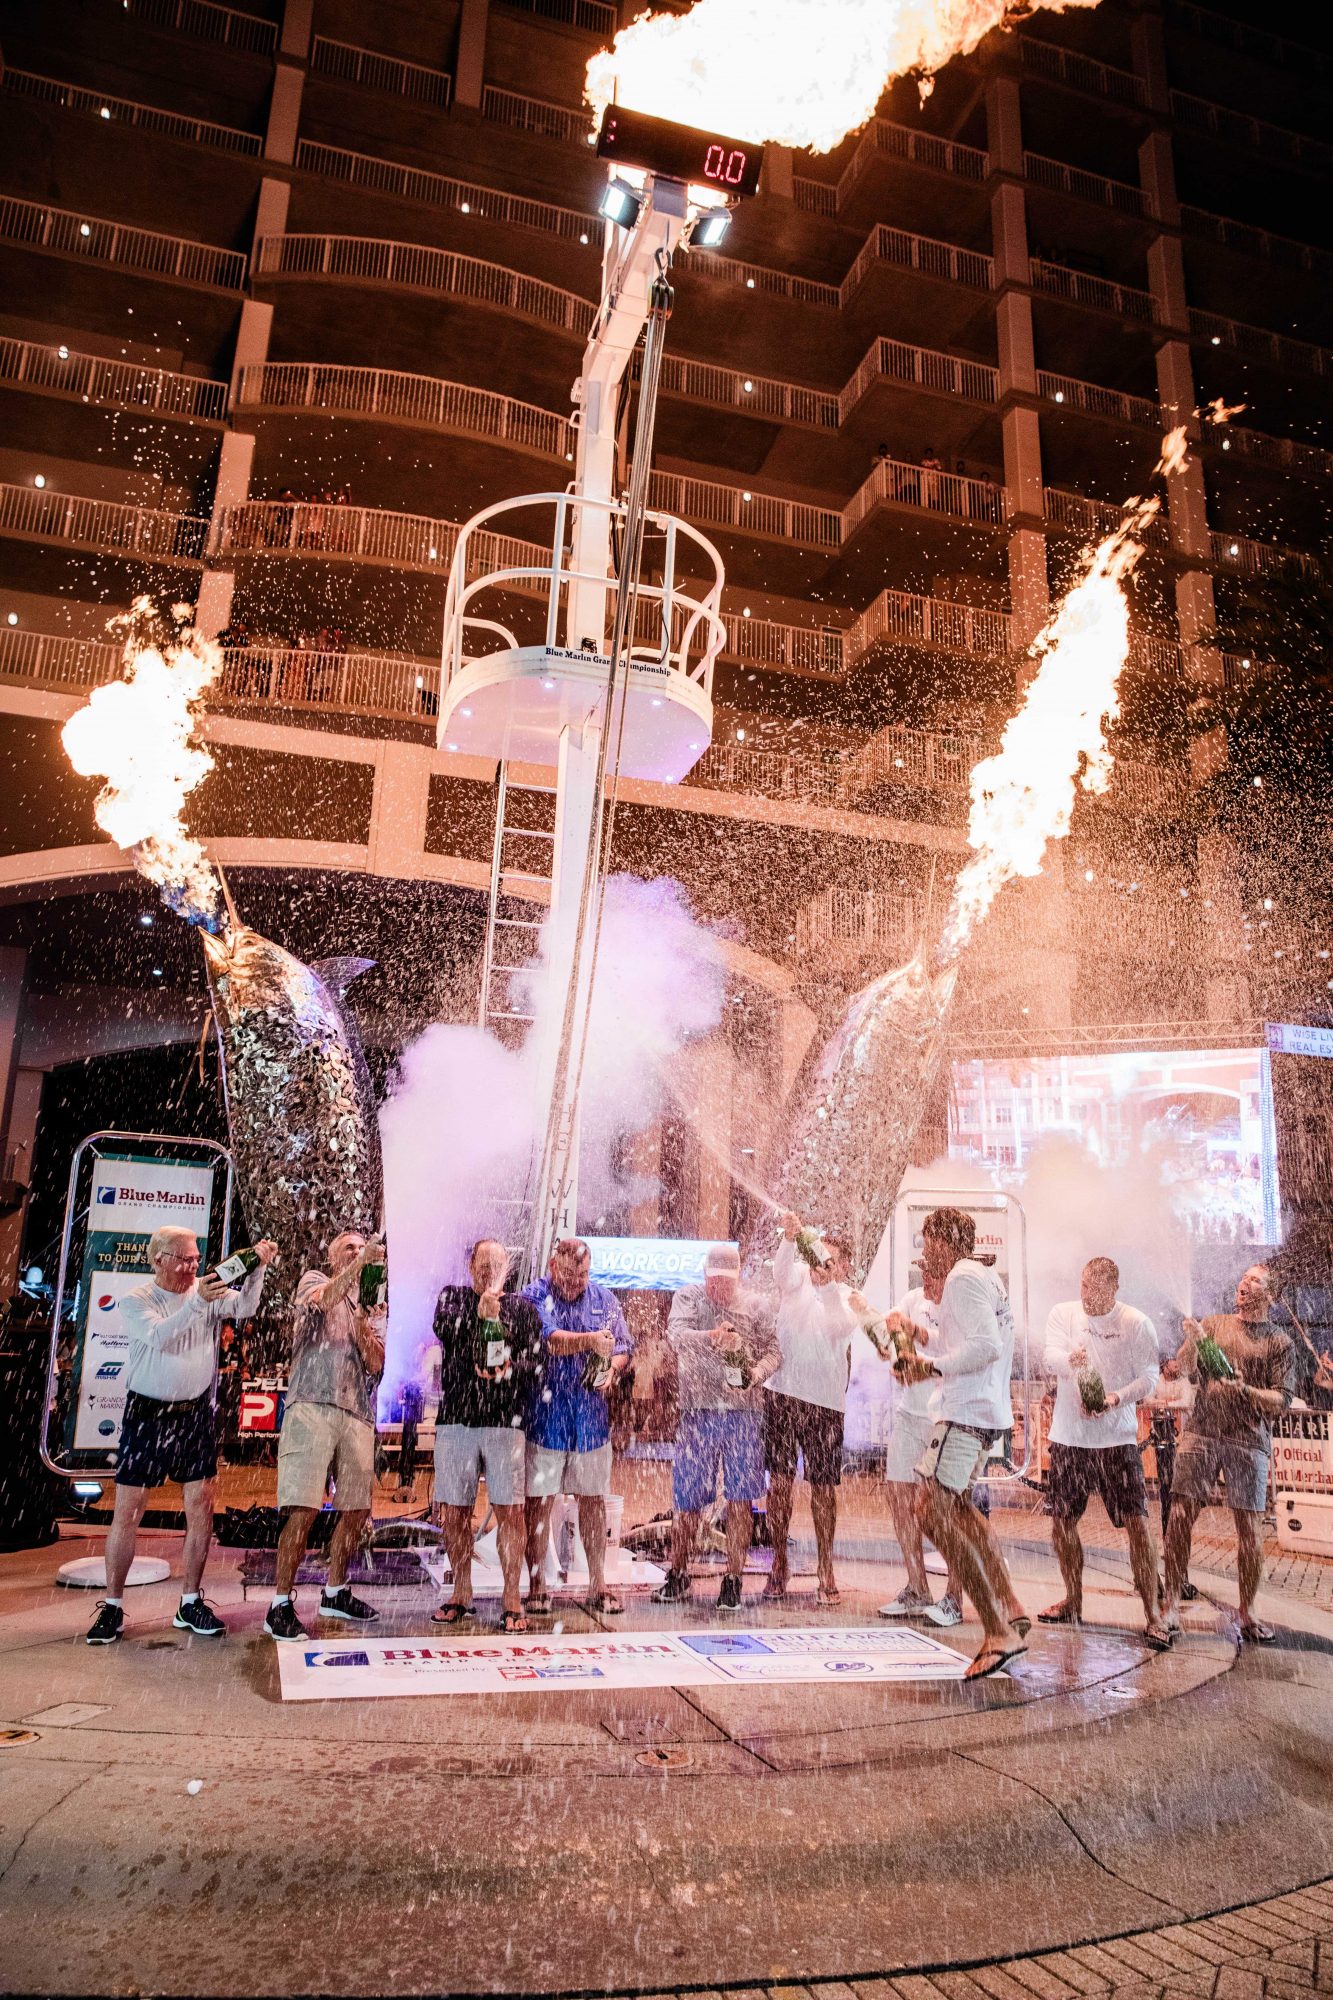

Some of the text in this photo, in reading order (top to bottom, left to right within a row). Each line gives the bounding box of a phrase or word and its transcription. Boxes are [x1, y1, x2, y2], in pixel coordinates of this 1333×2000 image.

[704, 145, 746, 184] 0.0
[545, 647, 563, 657] Blue
[565, 651, 591, 663] Marlin
[593, 656, 611, 665] Gran
[1293, 1029, 1317, 1040] WISE
[1290, 1041, 1317, 1052] REAL
[119, 1187, 205, 1206] Blue Marlin
[147, 1203, 205, 1212] CHAMPIONSHIP
[974, 1234, 1003, 1245] arlin
[98, 1253, 112, 1262] TO
[116, 1253, 138, 1264] OUR
[601, 1251, 658, 1271] WORK
[665, 1253, 692, 1273] OF
[1271, 1420, 1328, 1436] HARF
[1283, 1448, 1323, 1462] Official
[380, 1644, 676, 1660] Blue Marlin
